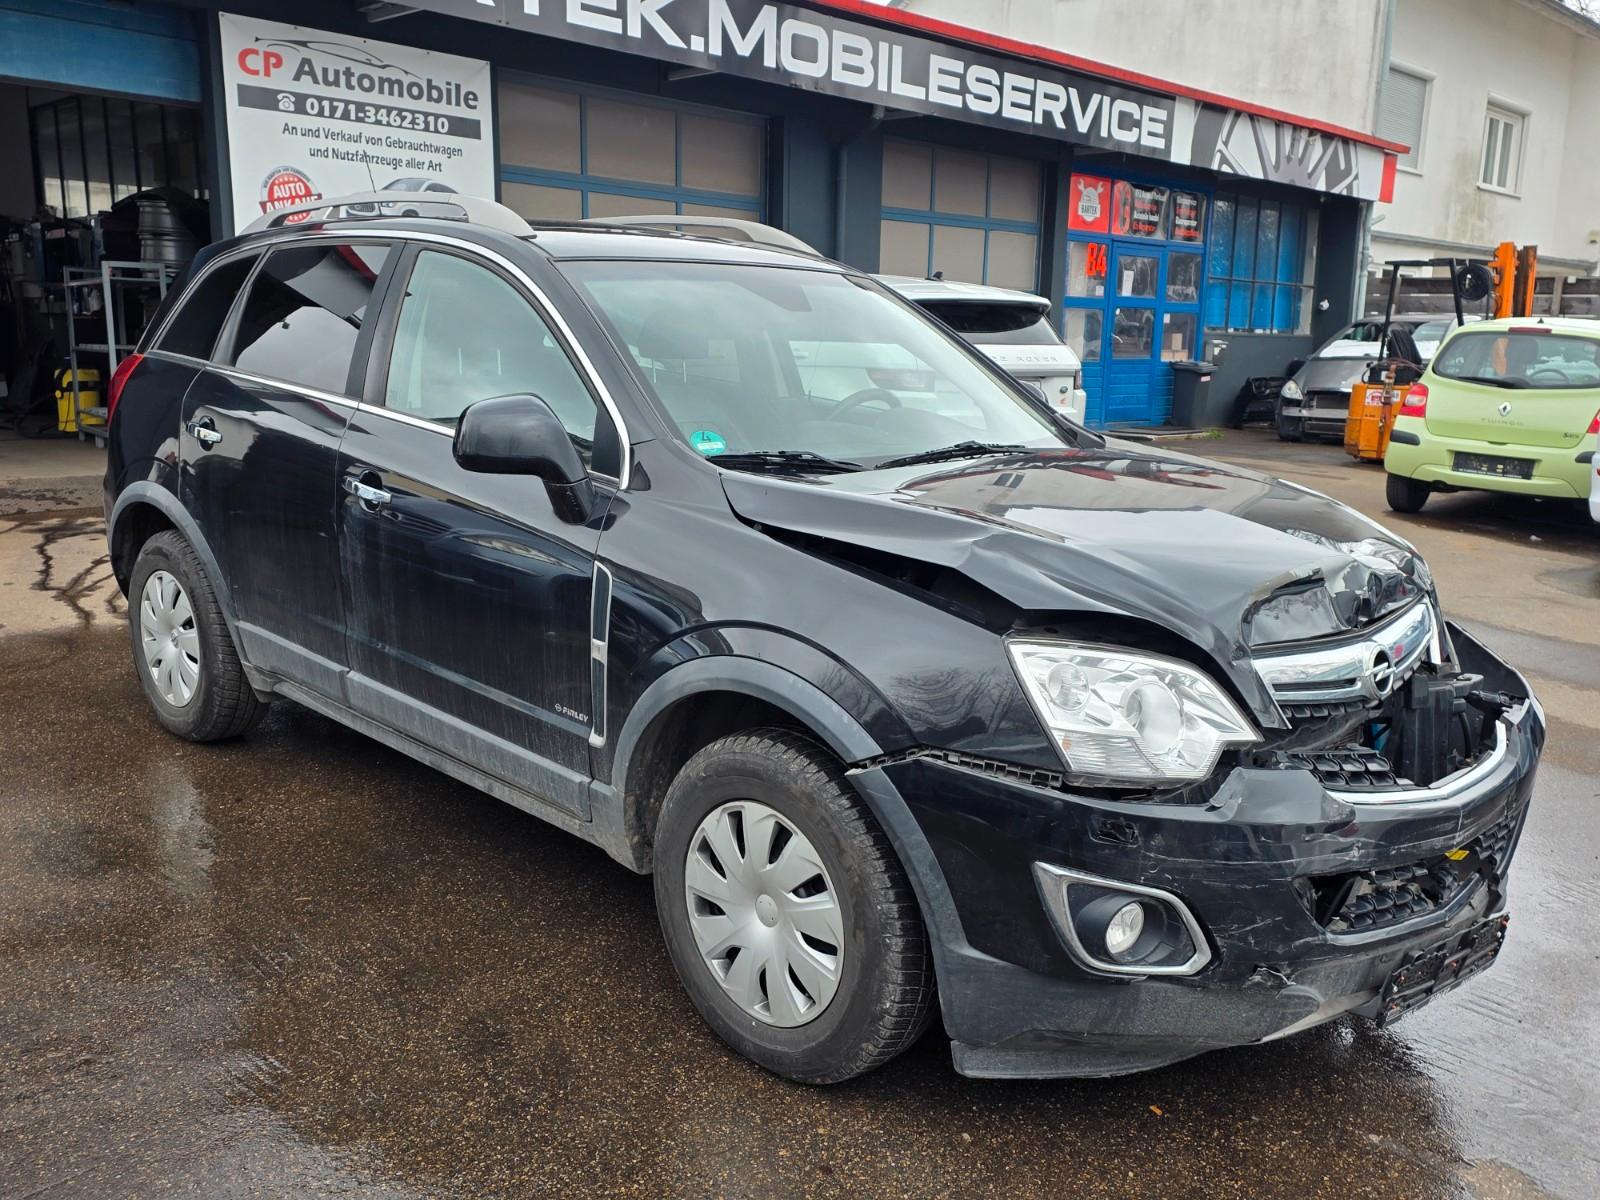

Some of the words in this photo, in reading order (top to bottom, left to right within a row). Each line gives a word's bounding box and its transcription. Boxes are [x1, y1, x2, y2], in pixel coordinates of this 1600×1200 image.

[237, 48, 283, 77] CP
[292, 57, 479, 110] Automobile
[306, 98, 449, 133] 0171-3462310
[282, 122, 298, 136] An
[300, 125, 320, 138] und
[322, 127, 362, 144] Verkauf
[364, 136, 383, 147] von
[385, 136, 463, 158] Gebrauchtwagen
[309, 147, 329, 159] und
[331, 148, 403, 169] Nutzfahrzeuge
[405, 158, 425, 170] aller
[427, 160, 442, 172] Art
[273, 182, 305, 199] AUTO
[1086, 243, 1107, 277] 84
